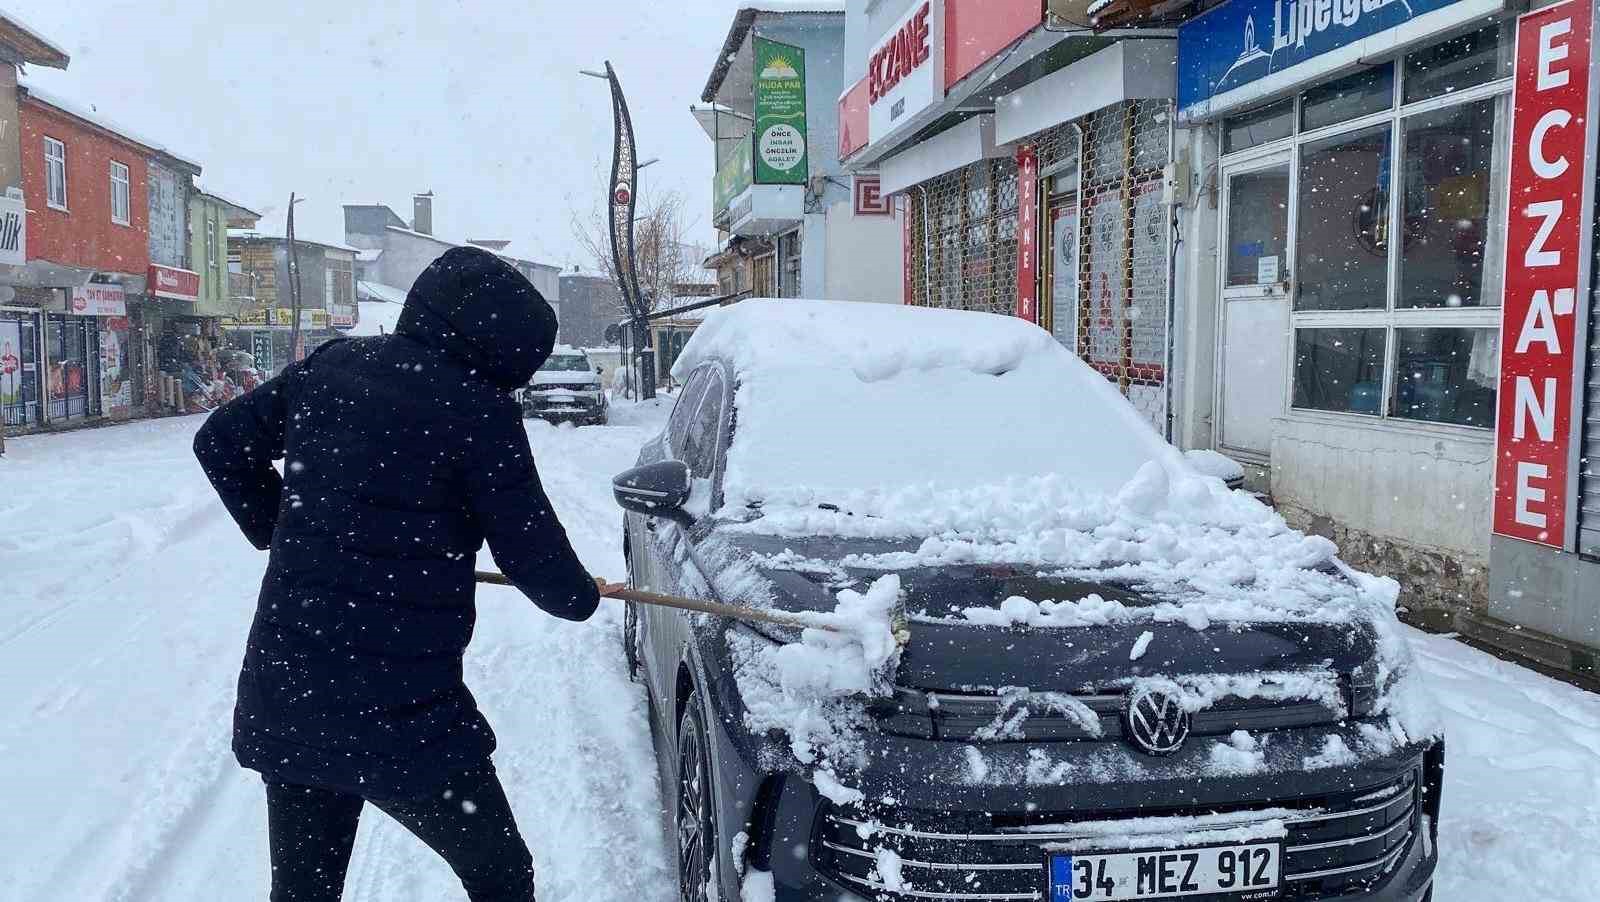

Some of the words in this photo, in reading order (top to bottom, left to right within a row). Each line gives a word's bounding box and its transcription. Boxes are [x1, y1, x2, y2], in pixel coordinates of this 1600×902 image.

[869, 1, 930, 105] ECZANE
[1515, 18, 1571, 529] ECZANE
[1056, 885, 1071, 897] TR
[1073, 858, 1115, 899] 34
[1136, 853, 1199, 895] MEZ
[1217, 847, 1271, 889] 912
